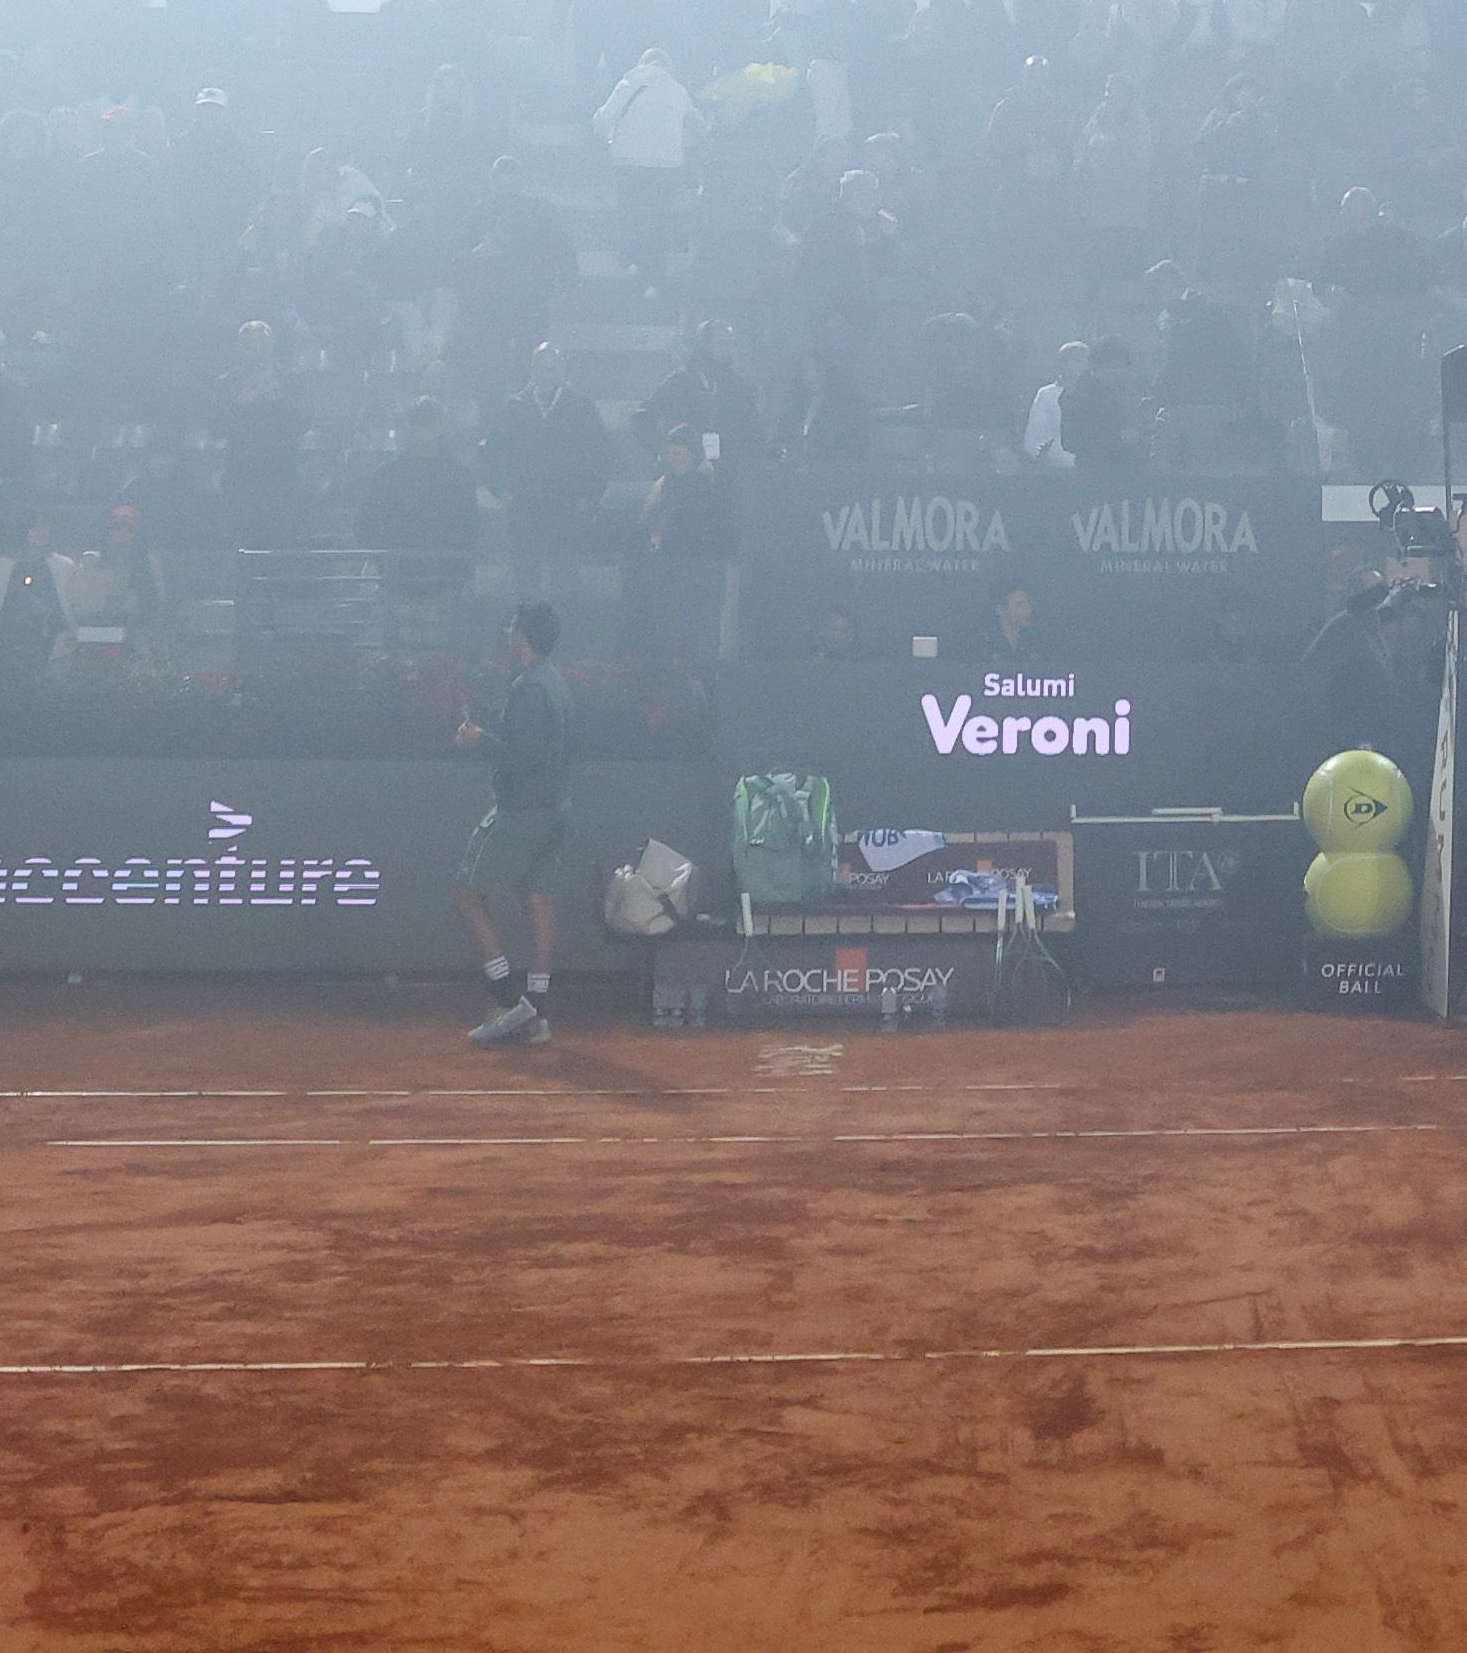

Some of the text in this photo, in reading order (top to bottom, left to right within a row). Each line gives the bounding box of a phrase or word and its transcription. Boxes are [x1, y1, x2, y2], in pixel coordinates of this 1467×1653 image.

[823, 495, 1011, 552] VALMORA
[1071, 496, 1260, 554] VALMORA
[984, 672, 1076, 698] Salumi
[921, 694, 1131, 756] Veroni
[725, 966, 955, 993] LA ROCHE POSAY
[1320, 962, 1406, 978] OFFICIAL
[1338, 979, 1382, 995] BALL
